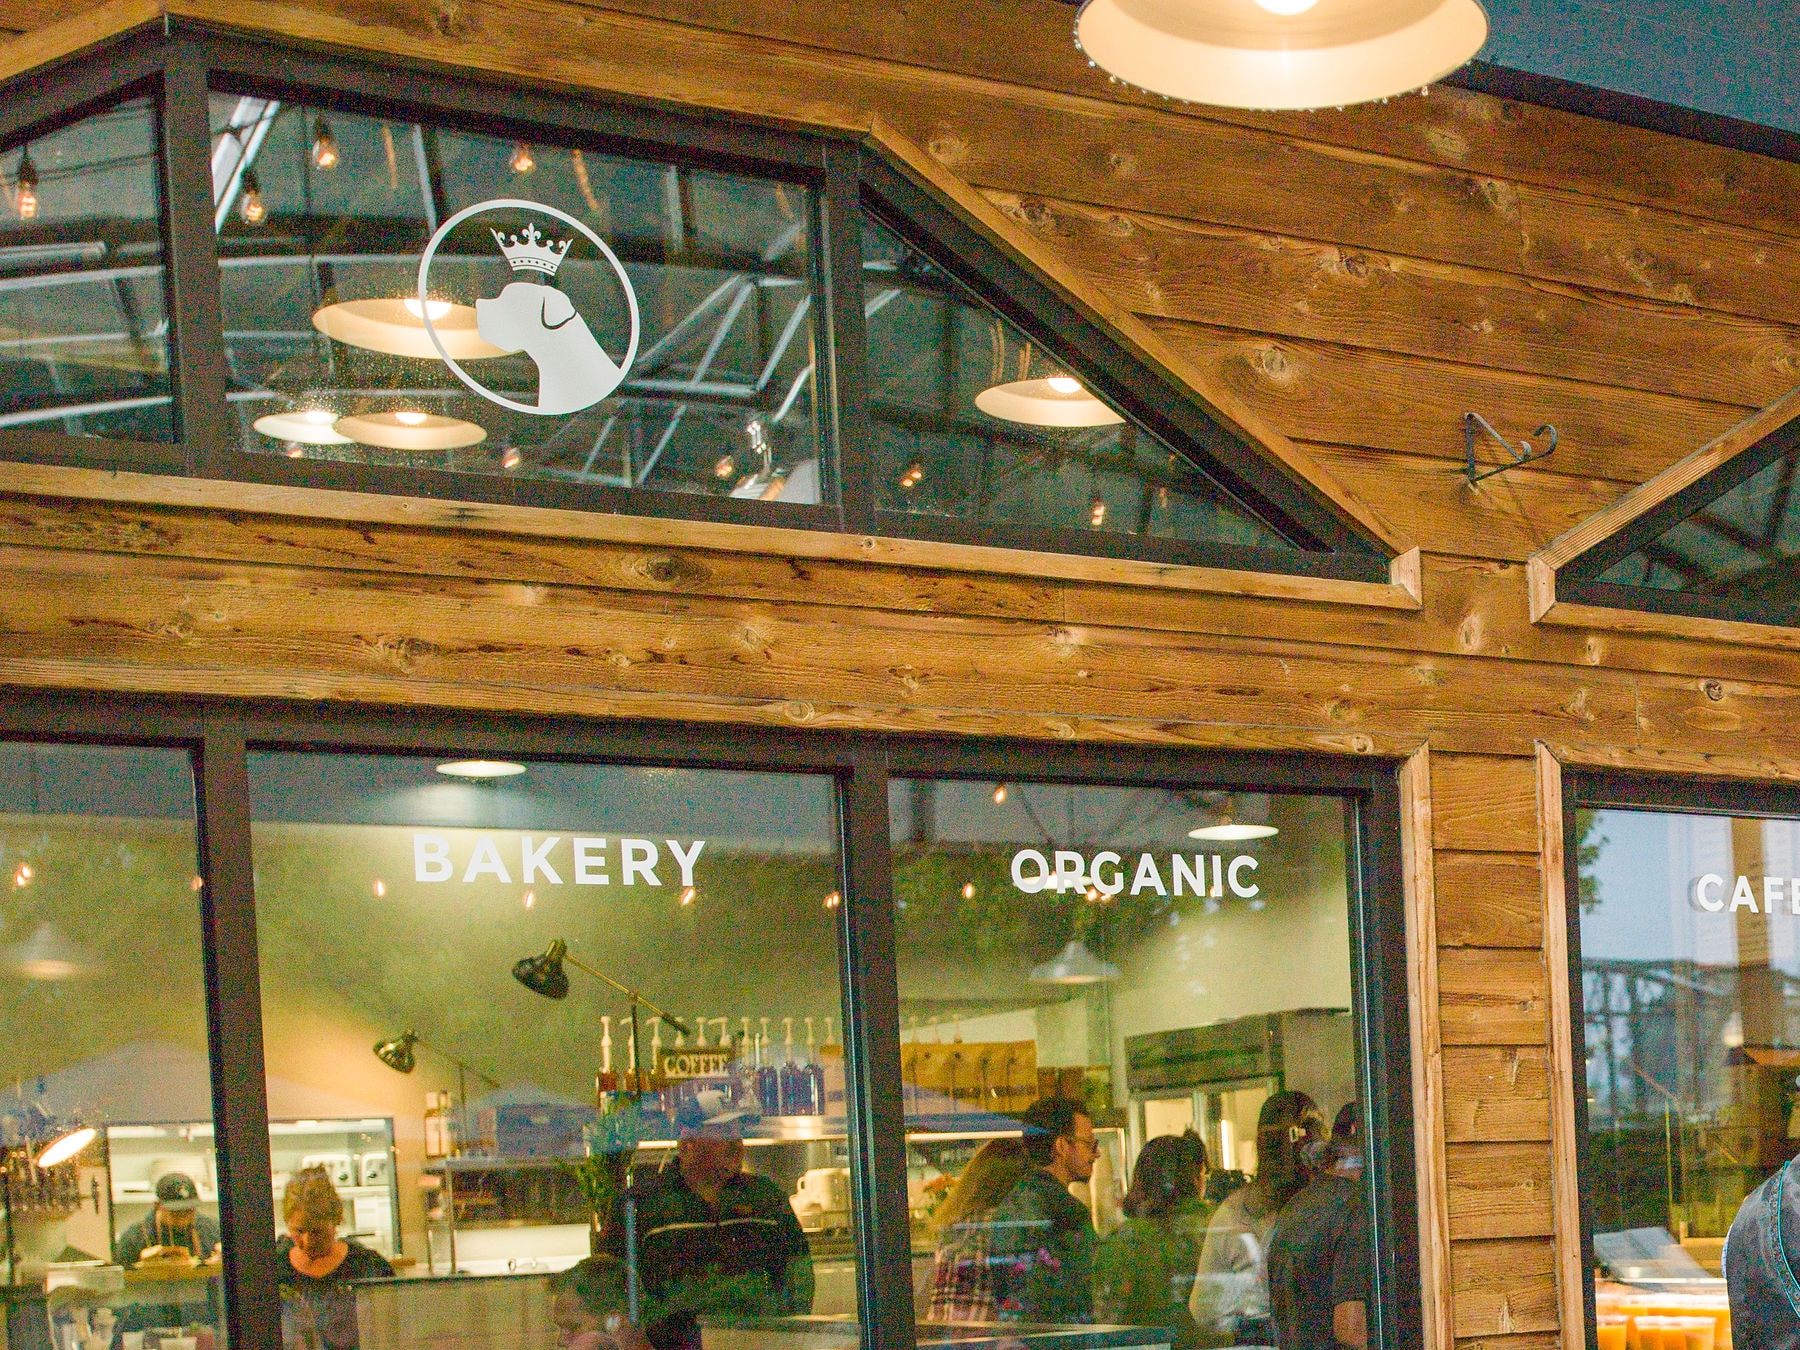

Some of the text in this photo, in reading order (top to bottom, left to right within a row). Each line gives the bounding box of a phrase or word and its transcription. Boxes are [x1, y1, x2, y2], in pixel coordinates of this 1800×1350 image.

[412, 833, 706, 887] BAKERY
[1010, 848, 1262, 898] ORGANIC
[664, 1053, 730, 1078] COFFEE
